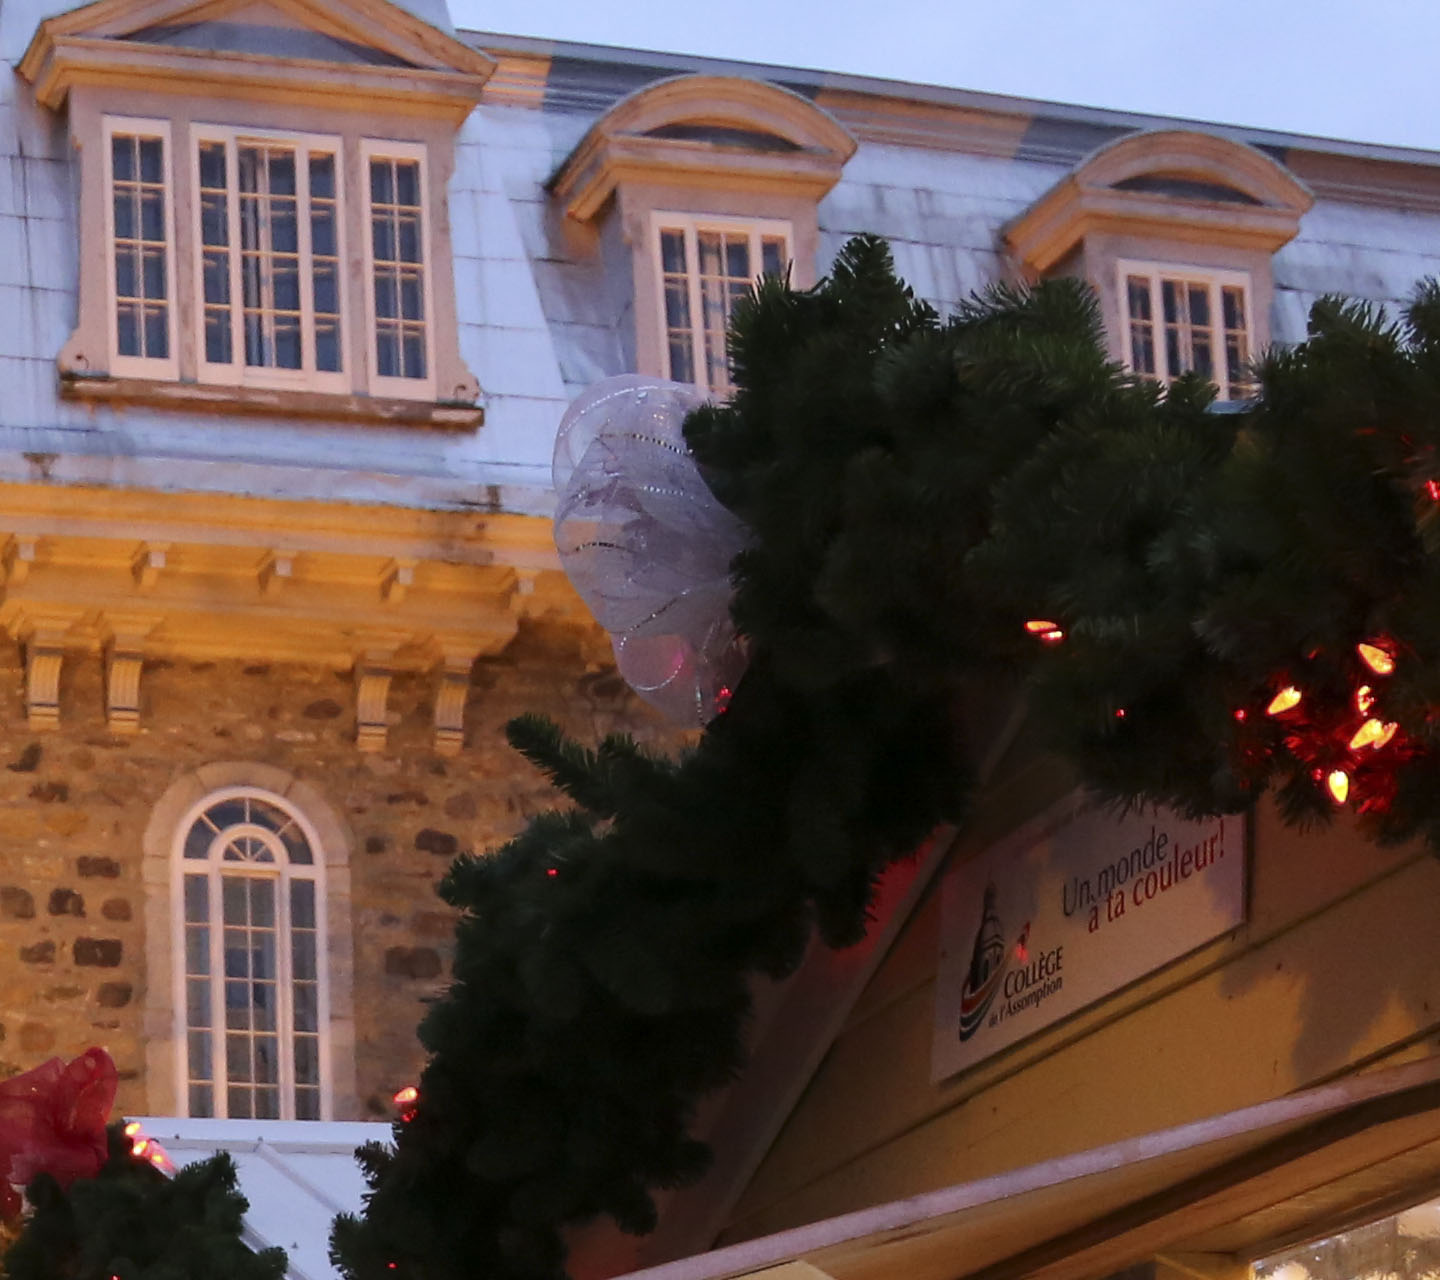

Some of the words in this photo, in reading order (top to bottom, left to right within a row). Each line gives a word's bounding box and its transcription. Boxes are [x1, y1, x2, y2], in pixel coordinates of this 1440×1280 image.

[1063, 876, 1091, 917] Un
[1098, 825, 1169, 897] monde
[1106, 888, 1126, 922] ta
[1132, 819, 1225, 907] couleur!
[1003, 946, 1064, 999] COLLÈGE
